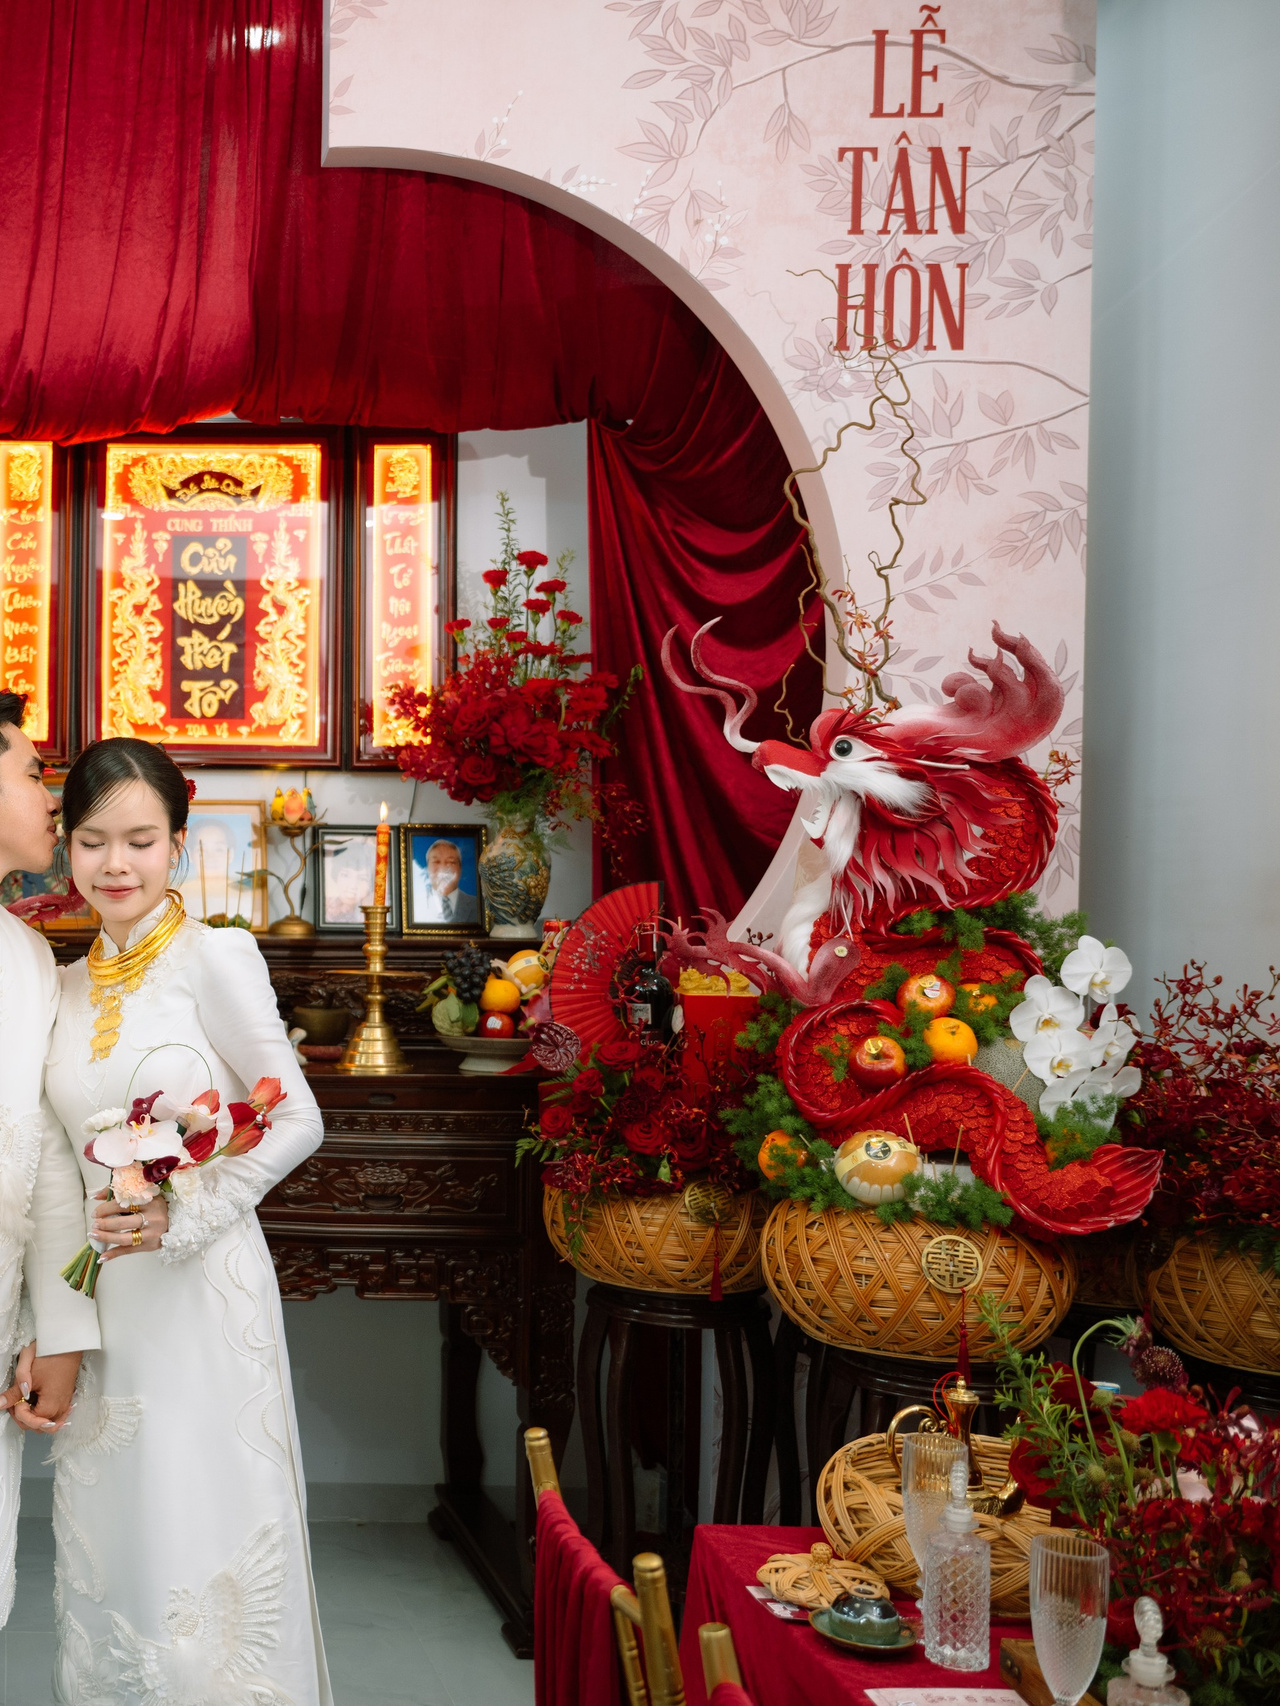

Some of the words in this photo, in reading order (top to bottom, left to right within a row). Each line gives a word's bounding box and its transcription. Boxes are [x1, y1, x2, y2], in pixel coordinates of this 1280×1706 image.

[870, 4, 946, 118] LỄ
[837, 131, 971, 235] TÂN
[833, 248, 969, 351] HÔN
[166, 519, 203, 532] CUNG
[180, 538, 237, 575] Cửu
[173, 580, 245, 624] Huyền
[4, 645, 37, 664] Bất
[176, 623, 238, 673] Thất
[180, 679, 239, 718] Tổ
